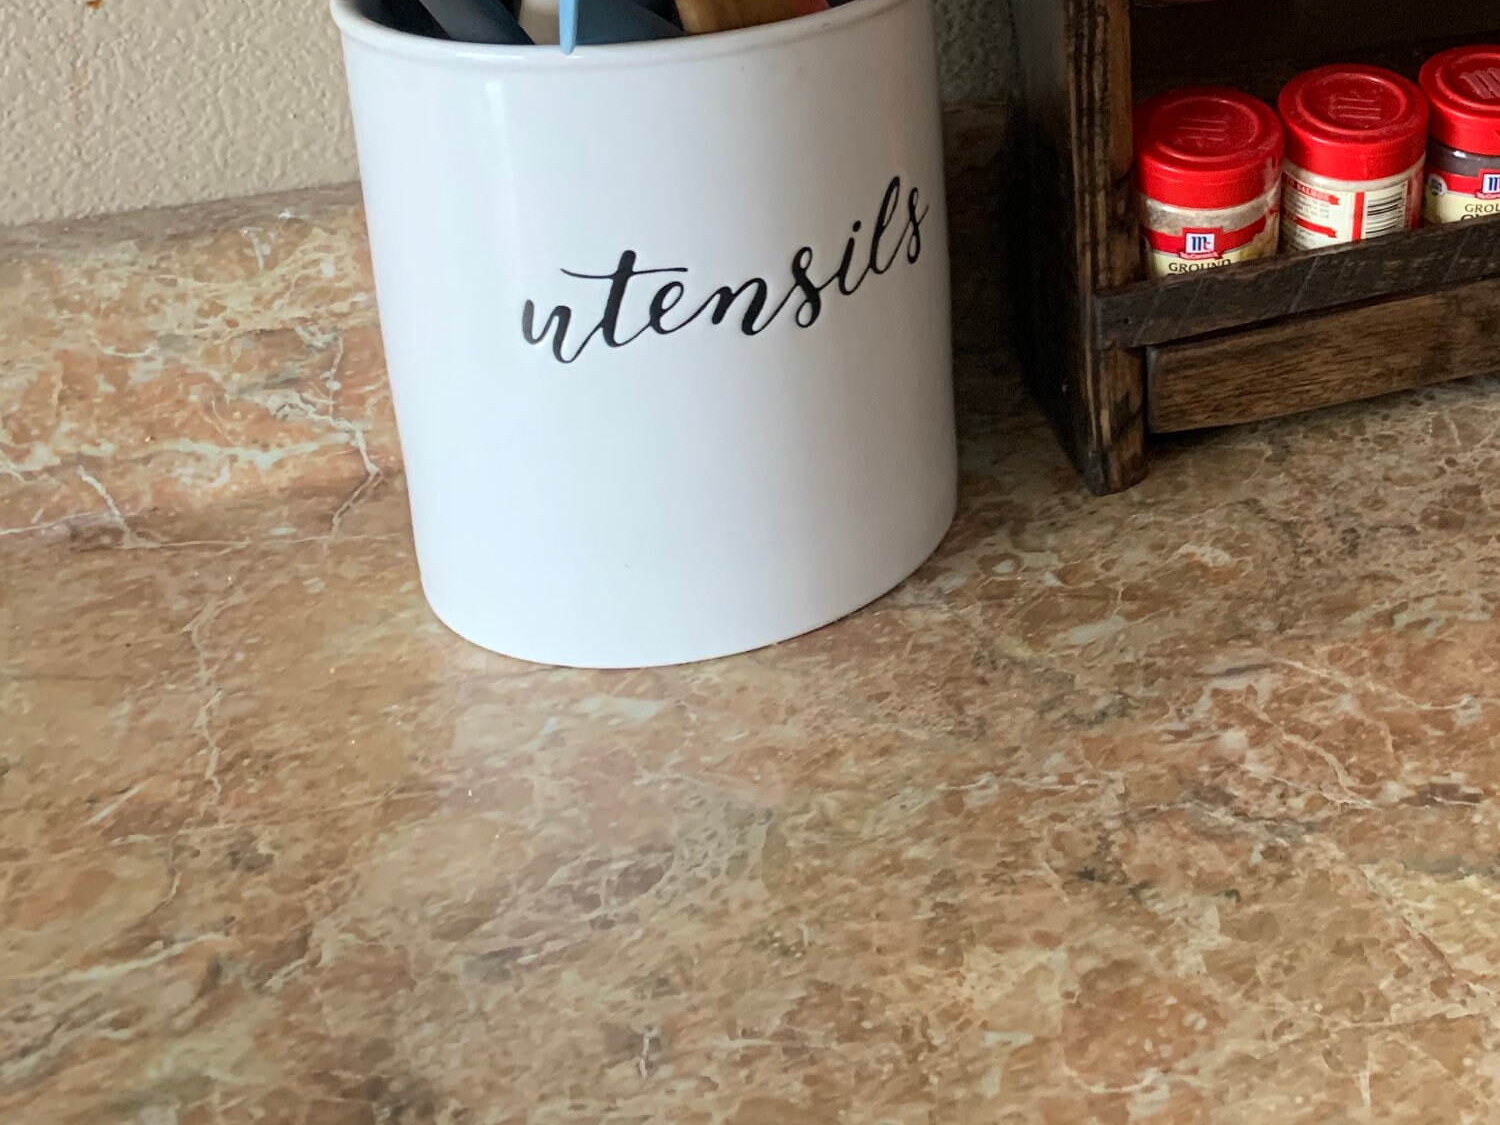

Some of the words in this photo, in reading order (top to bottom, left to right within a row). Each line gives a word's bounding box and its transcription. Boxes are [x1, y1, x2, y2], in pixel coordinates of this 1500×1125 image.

[1296, 182, 1330, 202] SALMON
[523, 176, 929, 363] utensils
[1168, 259, 1232, 273] GROUND
